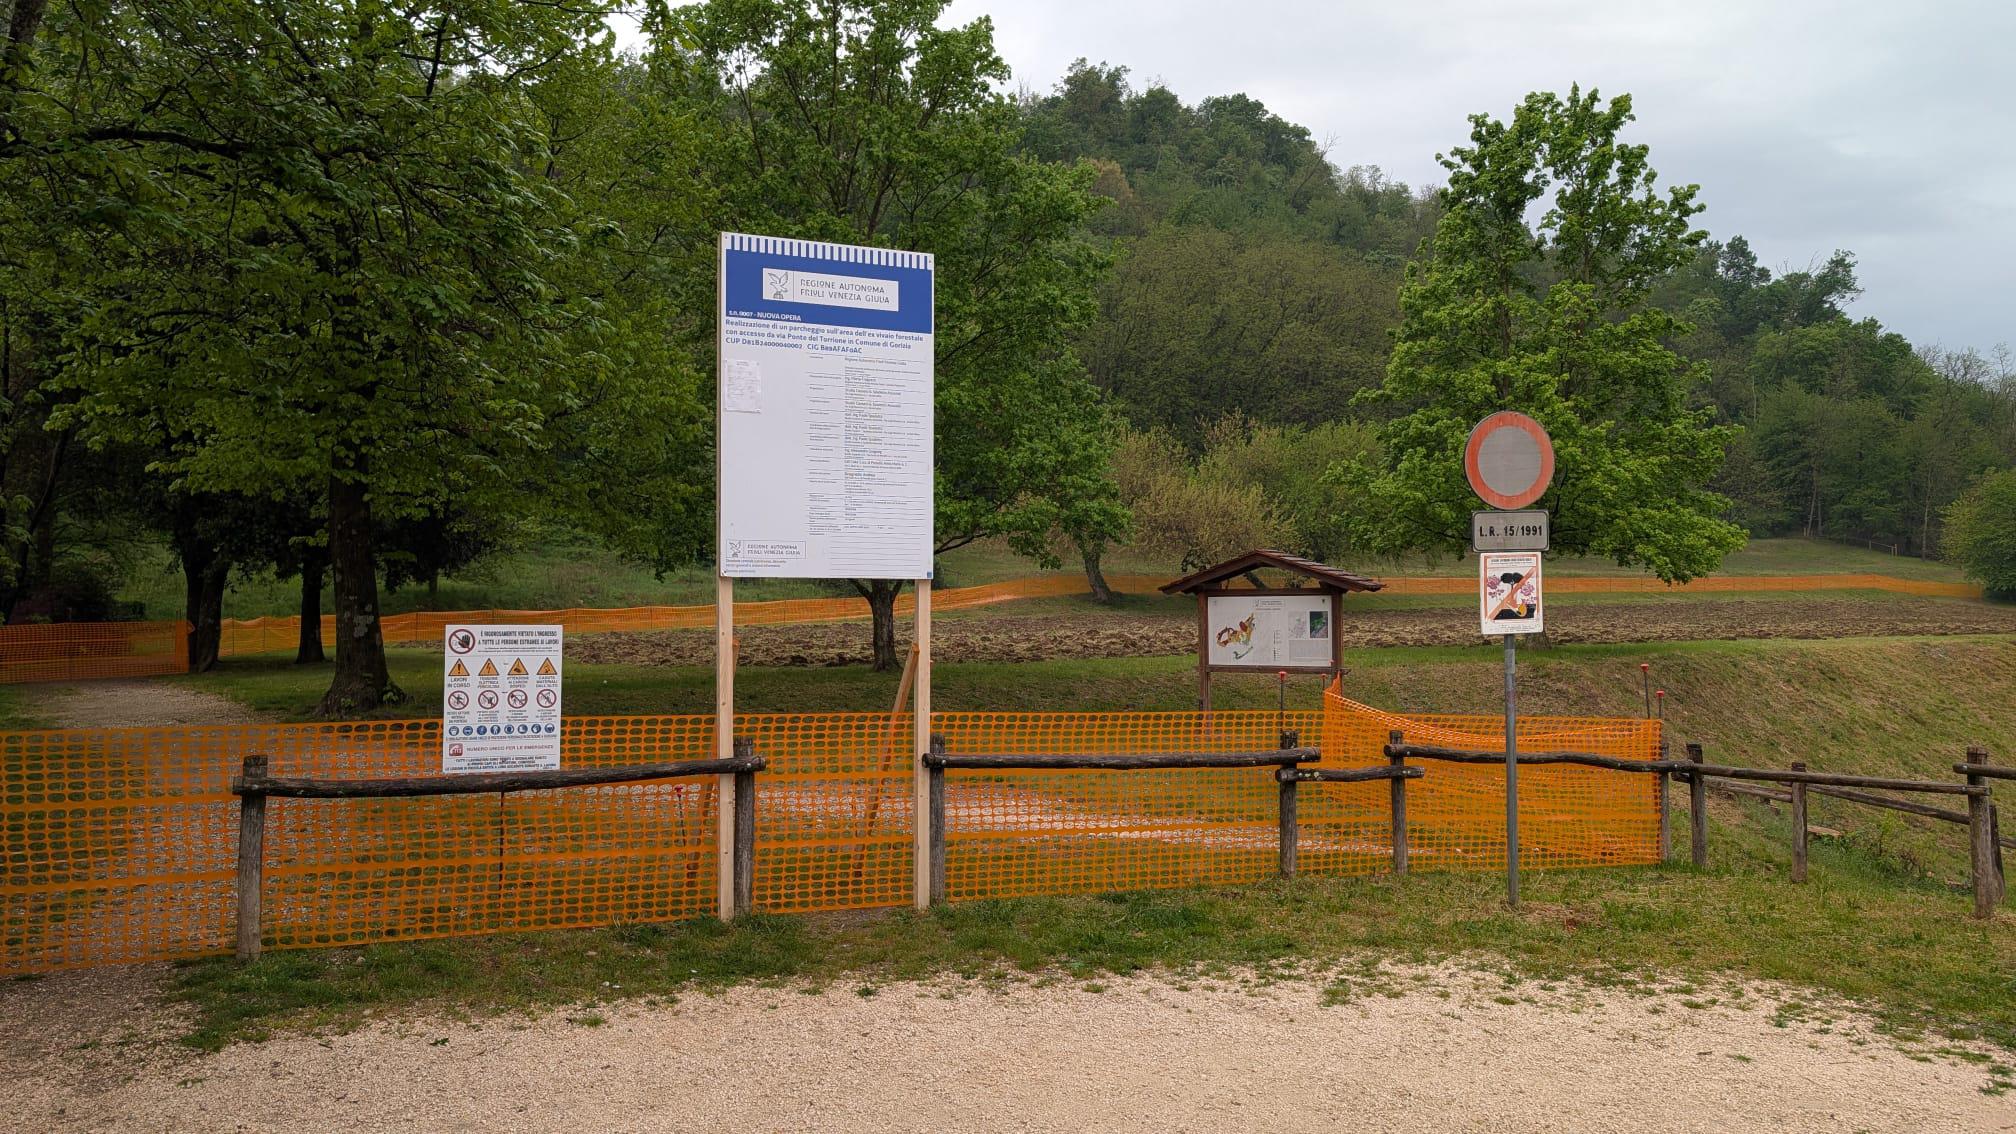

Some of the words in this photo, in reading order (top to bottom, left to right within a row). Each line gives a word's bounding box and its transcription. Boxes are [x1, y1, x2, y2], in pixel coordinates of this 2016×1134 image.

[800, 278, 836, 290] REGIONE
[840, 282, 885, 294] AUTONOMA
[800, 288, 825, 298] FRIULI
[828, 291, 862, 301] VENEZIA
[865, 294, 890, 304] GIULIA
[757, 311, 780, 320] NUOVA
[780, 313, 802, 321] OPERA
[725, 319, 770, 329] Realizzazione
[772, 322, 778, 330] di
[789, 325, 825, 334] parcheggio
[826, 327, 854, 336] sull'area
[876, 332, 895, 340] vivaio
[896, 333, 924, 342] forestale
[725, 337, 740, 345] CUP
[806, 343, 819, 351] CIG
[740, 330, 766, 338] accesso
[787, 333, 807, 342] Ponte
[820, 336, 846, 345] Torrione
[855, 338, 881, 347] Comune
[889, 341, 912, 350] Gorizia
[1504, 524, 1542, 536] 15/1991
